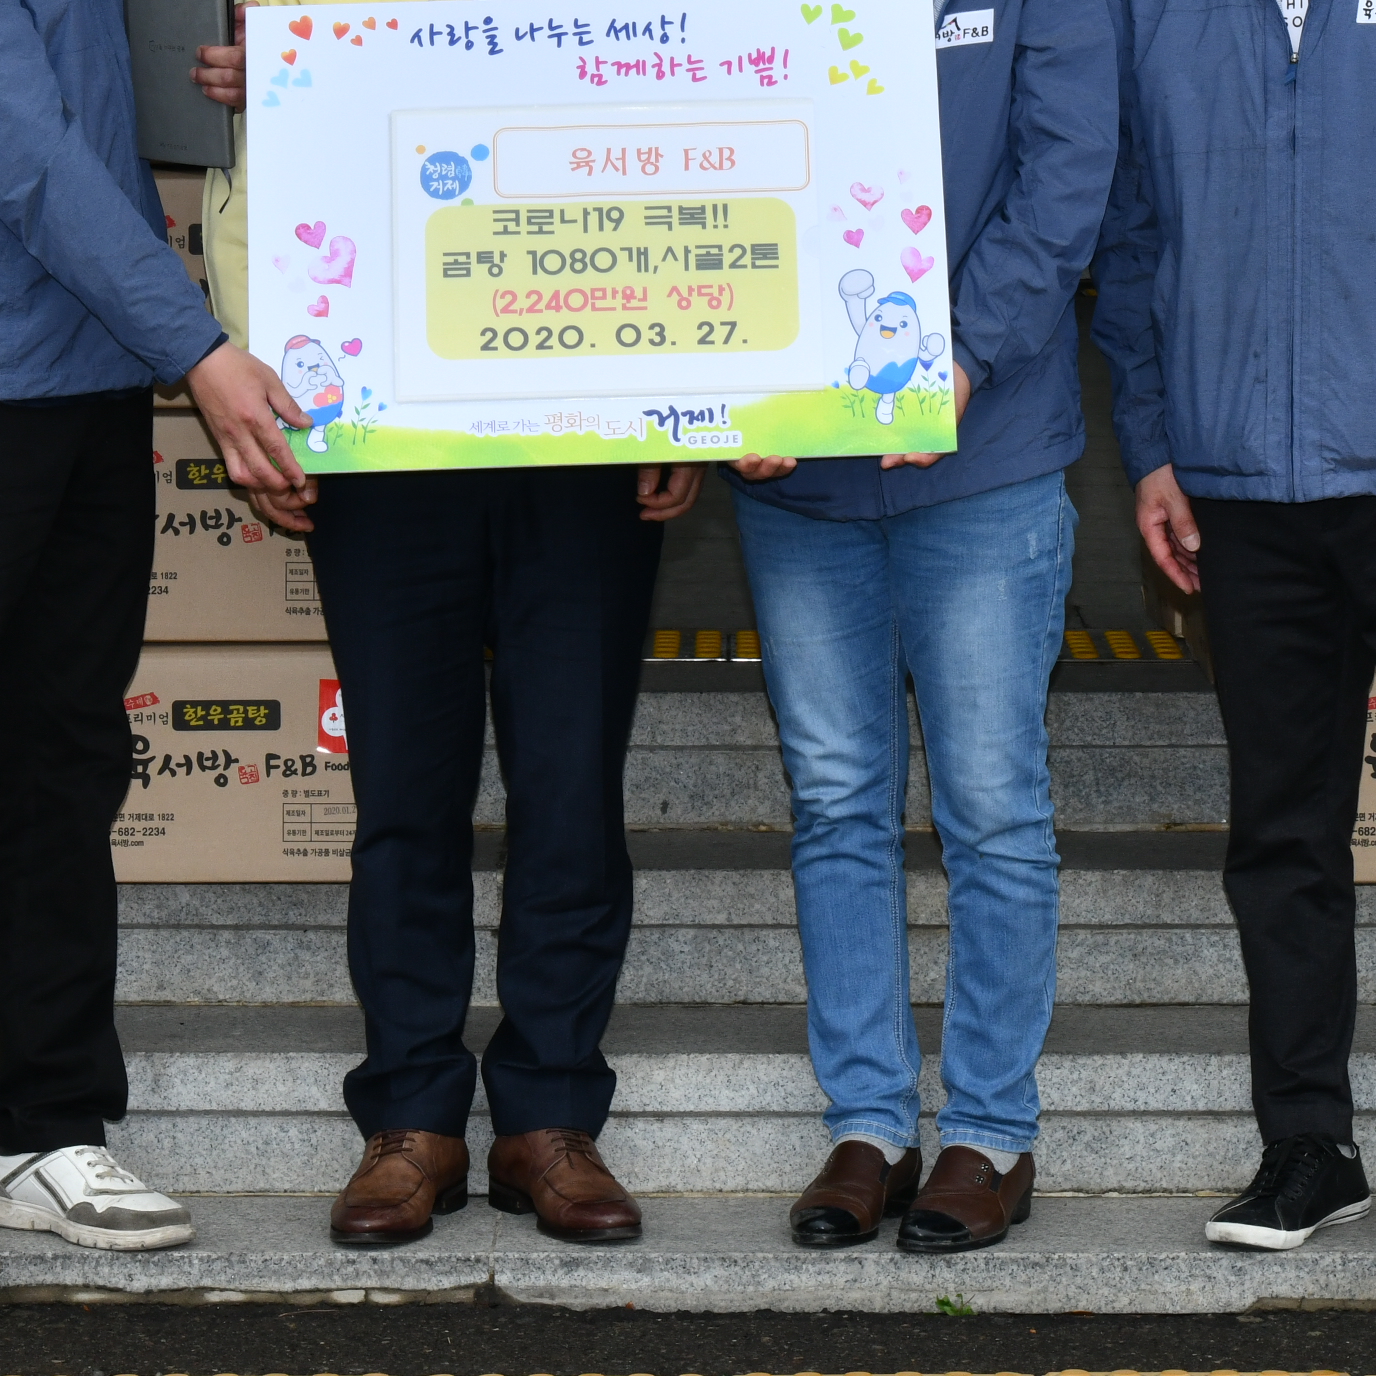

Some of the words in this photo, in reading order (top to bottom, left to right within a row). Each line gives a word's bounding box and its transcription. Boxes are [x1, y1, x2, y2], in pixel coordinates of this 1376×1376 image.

[410, 15, 504, 56] 사랑을
[514, 17, 594, 49] 나누는
[605, 12, 688, 45] 세상!
[963, 25, 989, 39] F&B
[576, 51, 708, 87] 함께하는
[719, 46, 790, 88] 기쁨!
[568, 145, 665, 177] 육서방
[682, 146, 737, 172] F&B
[492, 205, 625, 236] 코로나19
[643, 203, 730, 232] 극복!!
[442, 249, 508, 279] 곰탕
[526, 242, 780, 276] 1080개,사골2톤
[492, 285, 649, 318] (2,240만원
[666, 282, 735, 312] 상당)
[479, 324, 596, 352] 2020.
[615, 322, 677, 348] 03.
[696, 320, 749, 345] 27.
[469, 420, 511, 434] 세계로
[512, 419, 541, 433] 가는
[544, 411, 601, 433] 평화의
[604, 417, 643, 438] 도시
[642, 403, 727, 443] 거제!
[688, 434, 740, 445] GEOJE
